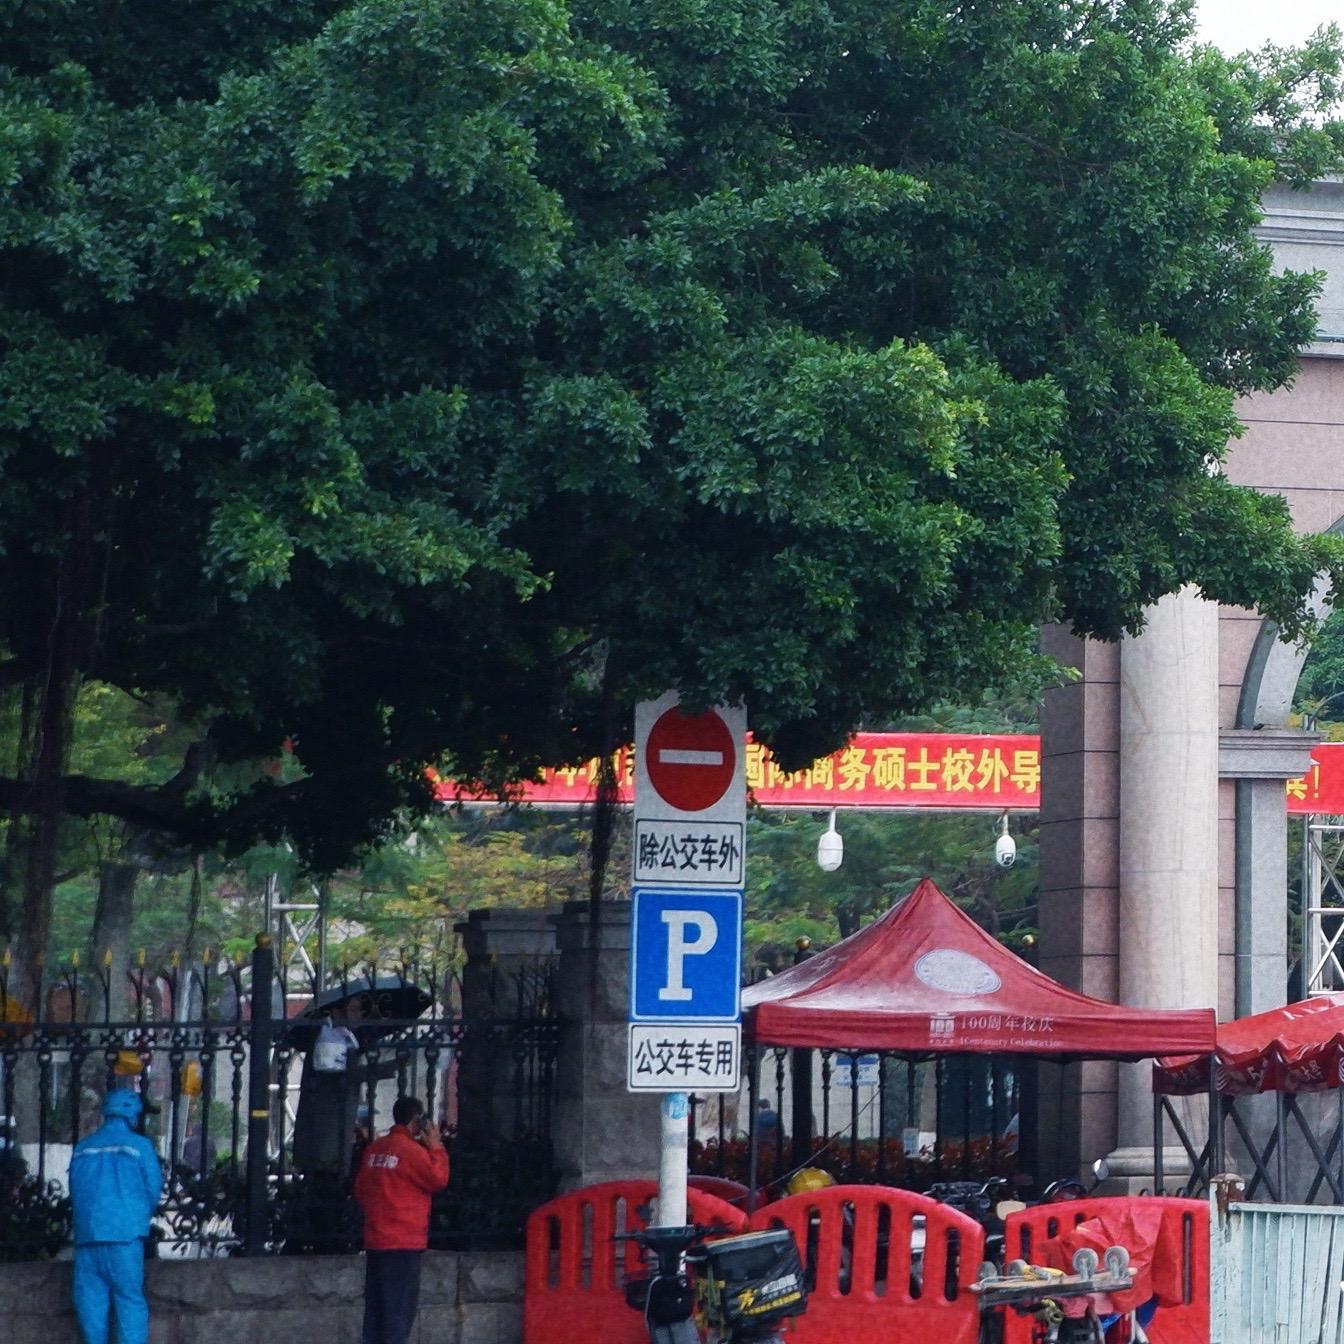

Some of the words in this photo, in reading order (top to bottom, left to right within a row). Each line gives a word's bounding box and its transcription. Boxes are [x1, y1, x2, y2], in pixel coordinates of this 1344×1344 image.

[639, 832, 739, 872] 除公交车外
[658, 910, 718, 1001] P
[961, 1015, 1054, 1032] 100周年校庆
[635, 1038, 733, 1075] 公交车专用
